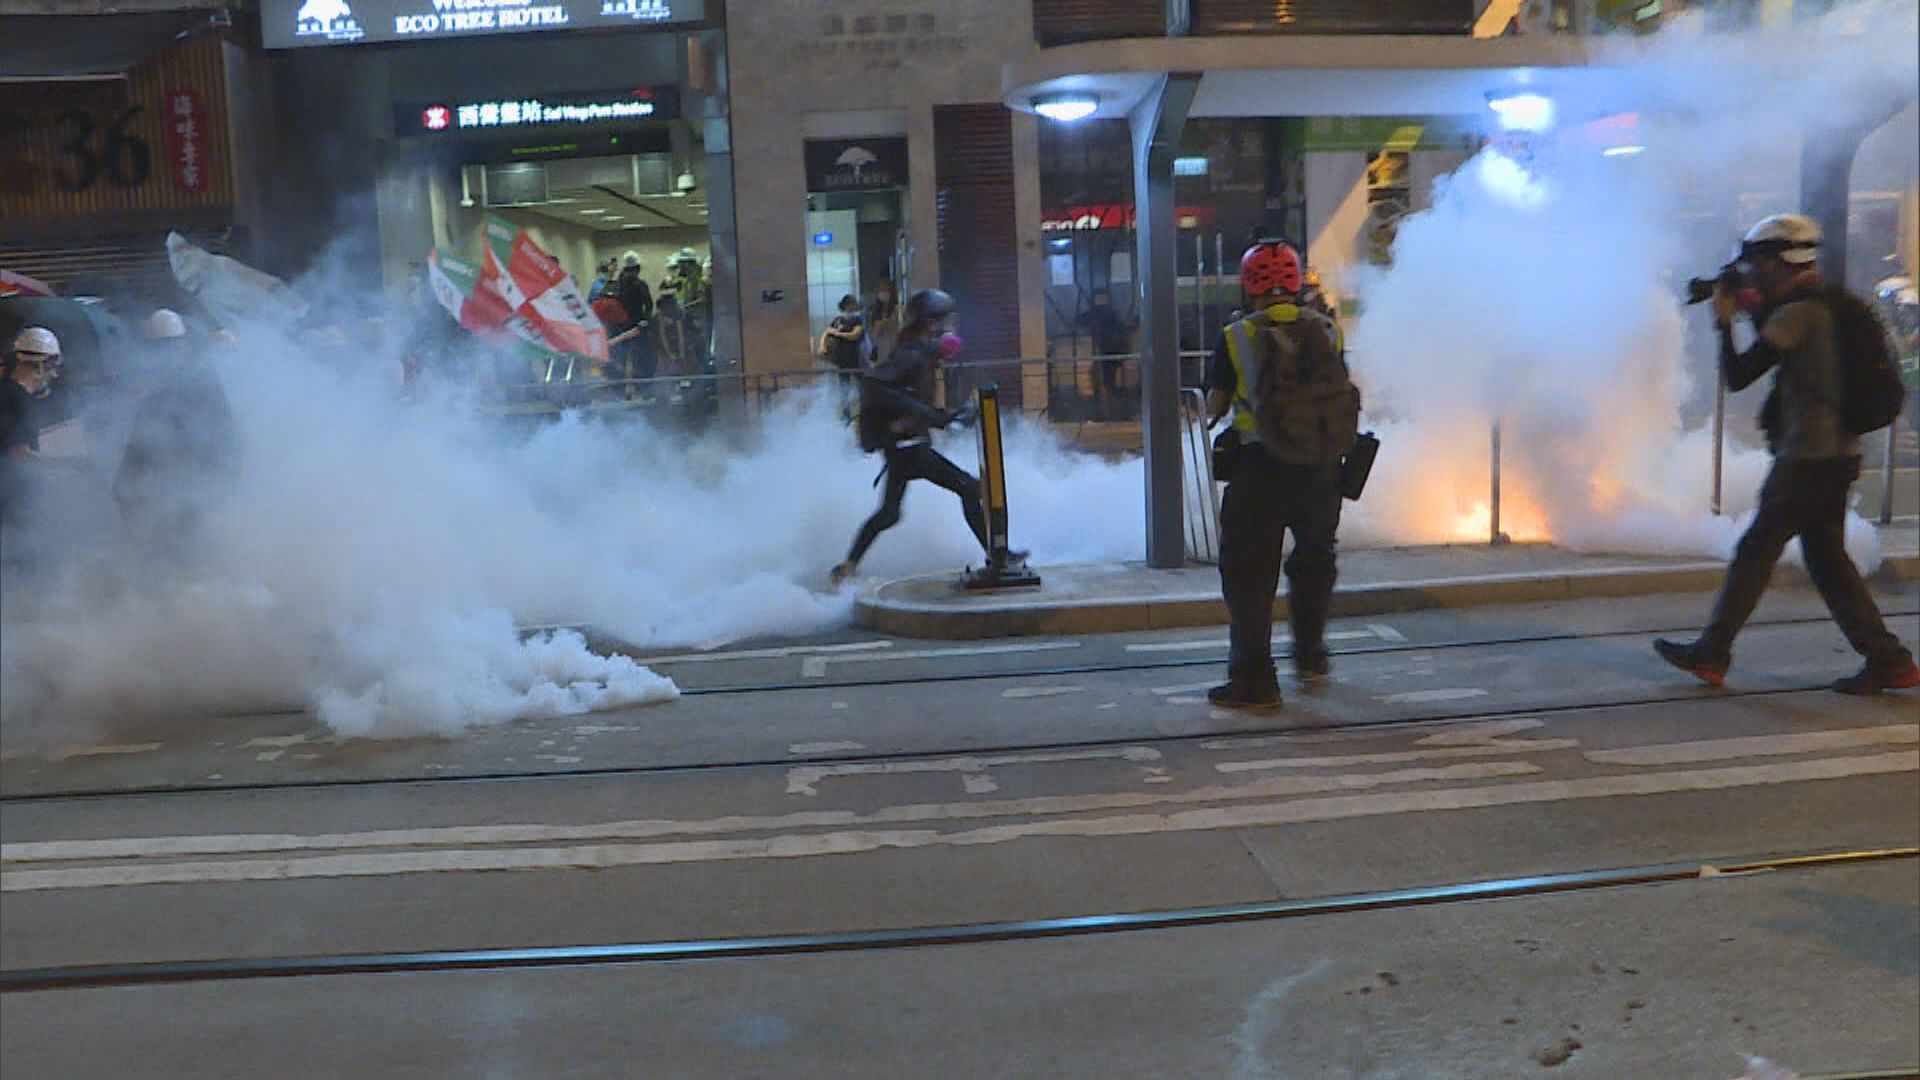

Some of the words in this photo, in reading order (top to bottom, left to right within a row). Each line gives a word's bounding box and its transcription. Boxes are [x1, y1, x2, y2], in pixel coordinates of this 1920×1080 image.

[395, 14, 439, 33] ECO
[441, 10, 496, 30] TREE
[498, 6, 569, 27] HOTEL
[612, 101, 654, 116] Station
